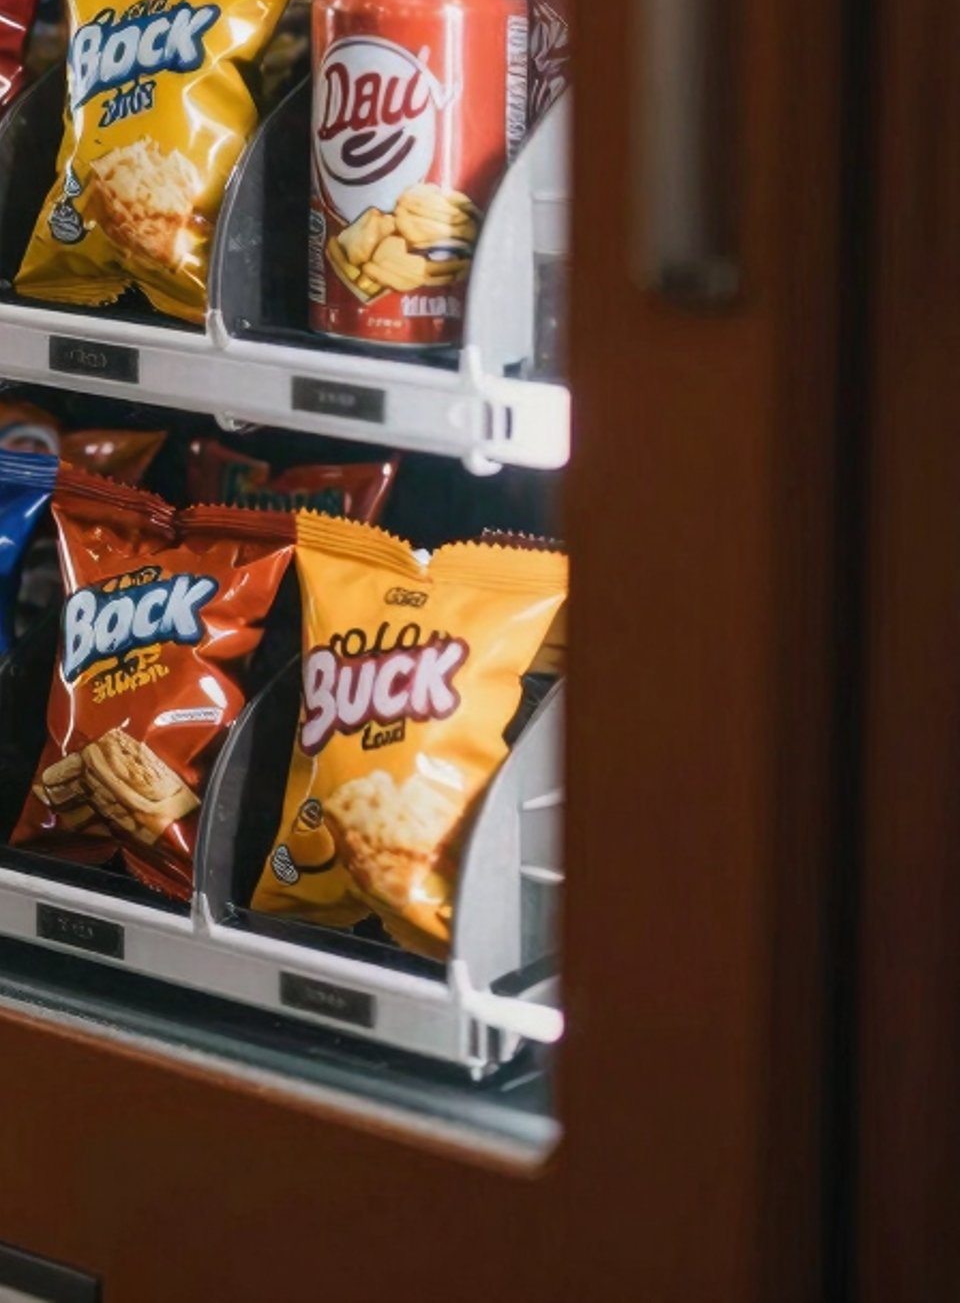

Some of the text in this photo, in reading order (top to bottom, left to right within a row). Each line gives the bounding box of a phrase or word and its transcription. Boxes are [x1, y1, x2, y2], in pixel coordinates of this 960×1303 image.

[70, 8, 214, 110] BOCK
[64, 575, 216, 679] BOCK
[301, 642, 463, 749] BUCK
